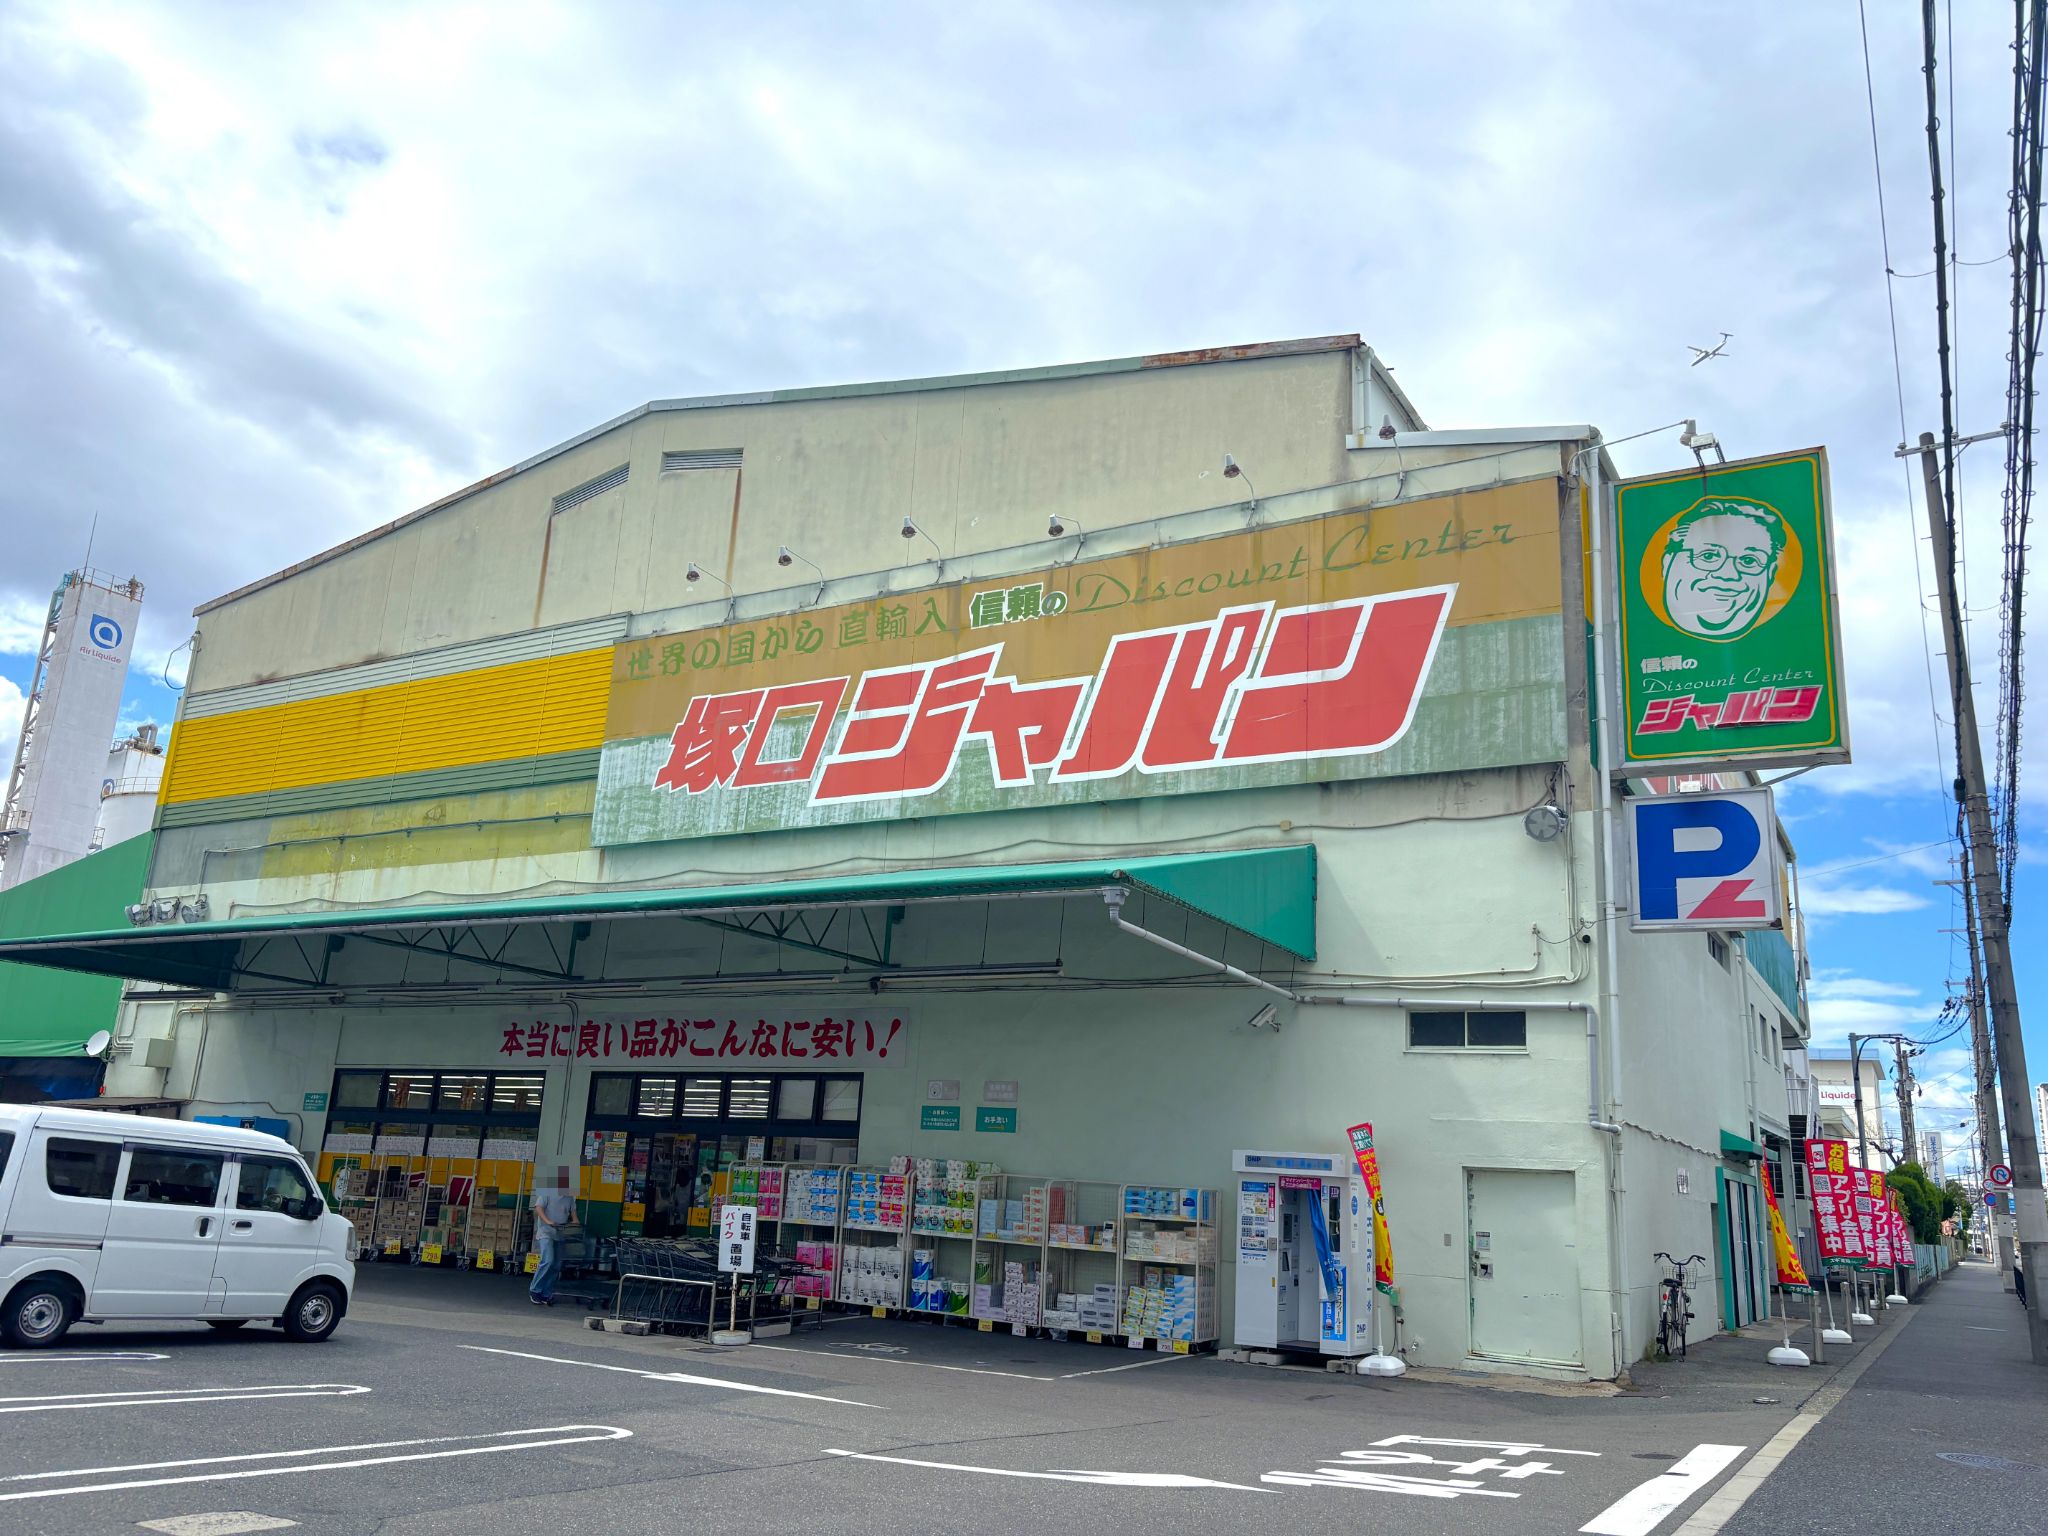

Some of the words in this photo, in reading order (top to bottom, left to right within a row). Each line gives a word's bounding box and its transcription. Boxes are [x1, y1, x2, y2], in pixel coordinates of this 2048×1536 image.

[1074, 545, 1307, 614] Discount
[1322, 519, 1519, 573] Center
[969, 583, 1068, 629] 信頼の
[92, 649, 121, 661] Liquide
[1640, 655, 1698, 674] 信頼の
[1642, 674, 1737, 695] Discount
[1743, 667, 1815, 684] Center
[1635, 685, 1823, 735] ジャパン
[1821, 1091, 1856, 1100] Liquide
[724, 1211, 736, 1239] バイク
[740, 1212, 751, 1241] 自転車
[1816, 1196, 1842, 1253] 募集中
[729, 1243, 743, 1267] 置場
